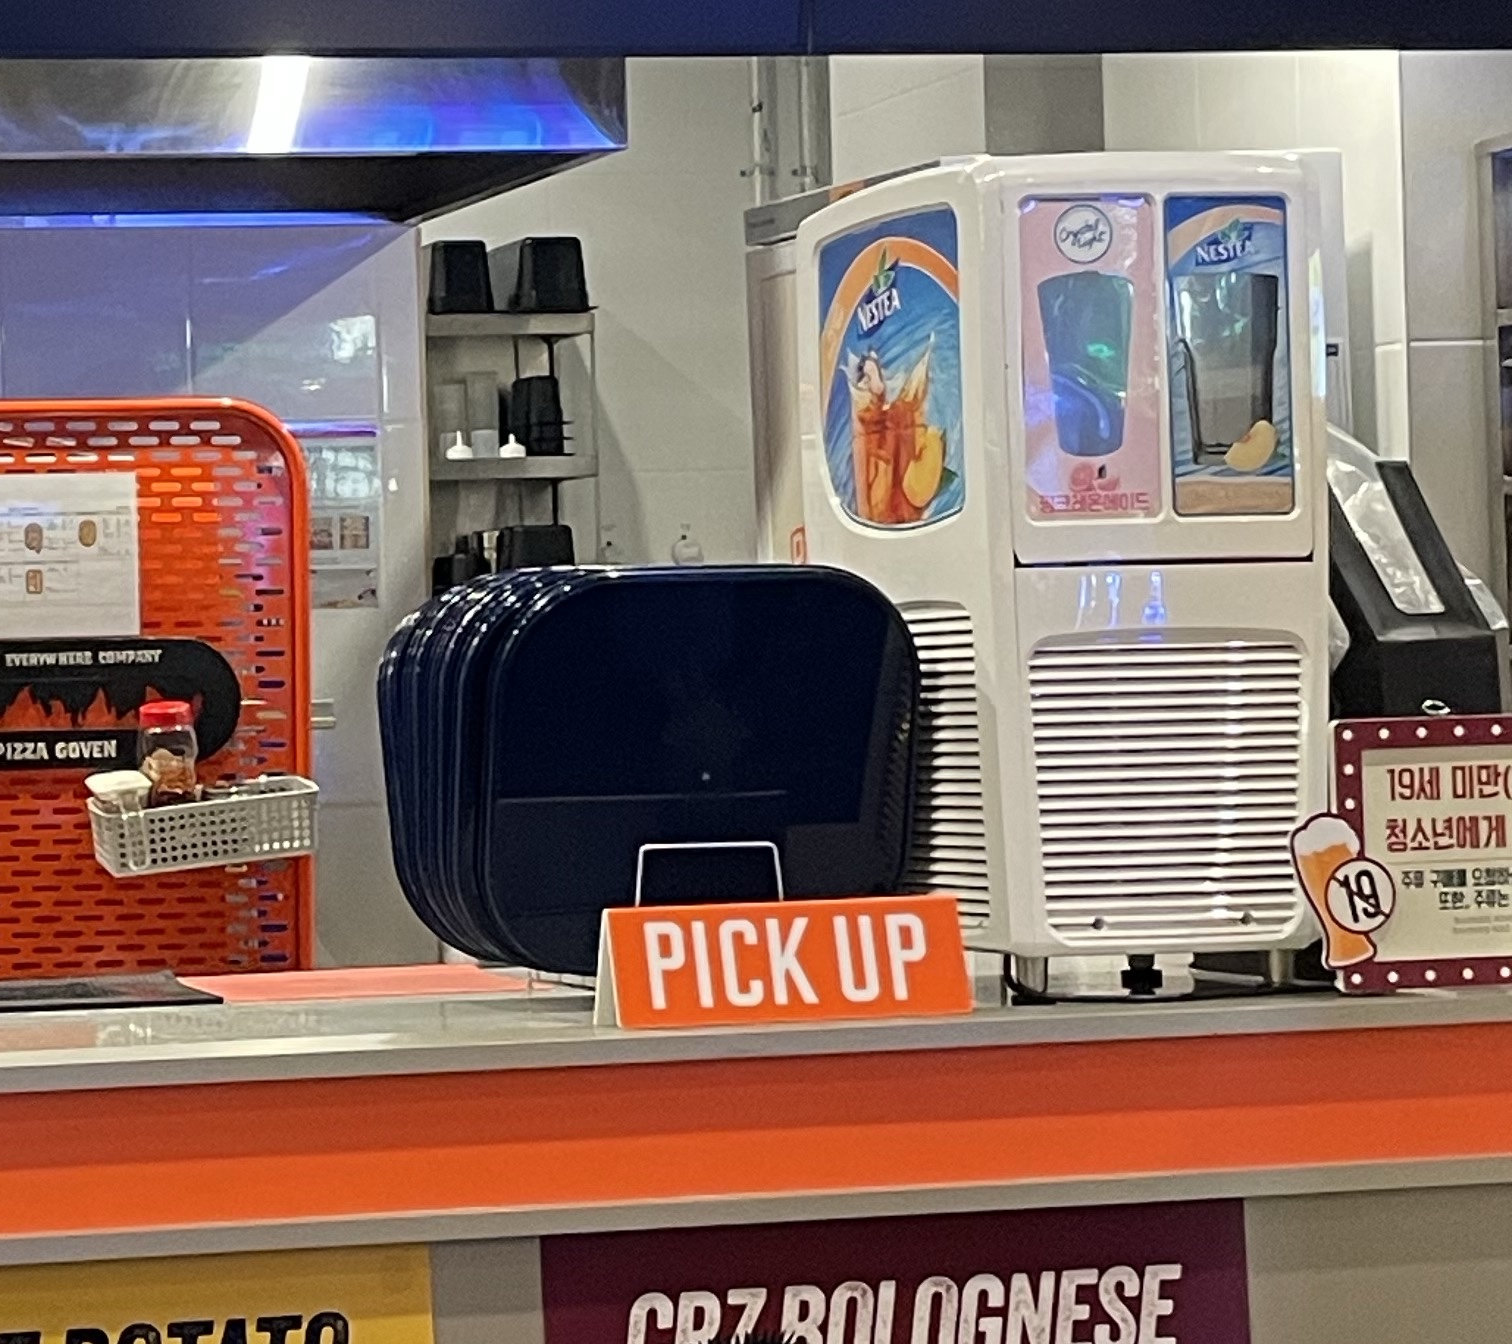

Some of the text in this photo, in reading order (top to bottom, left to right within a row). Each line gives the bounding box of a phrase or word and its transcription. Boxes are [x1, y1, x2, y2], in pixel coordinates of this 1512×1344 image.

[1195, 238, 1257, 263] NESTEA
[856, 287, 902, 332] NESTEA
[5, 651, 93, 667] EVERYWHERE
[98, 649, 162, 664] COMPANY
[55, 739, 117, 759] GOVEN
[1387, 765, 1441, 802] 19세
[1386, 814, 1507, 853] 청소년에게
[1343, 869, 1382, 924] 19
[643, 913, 927, 1010] PICK UP
